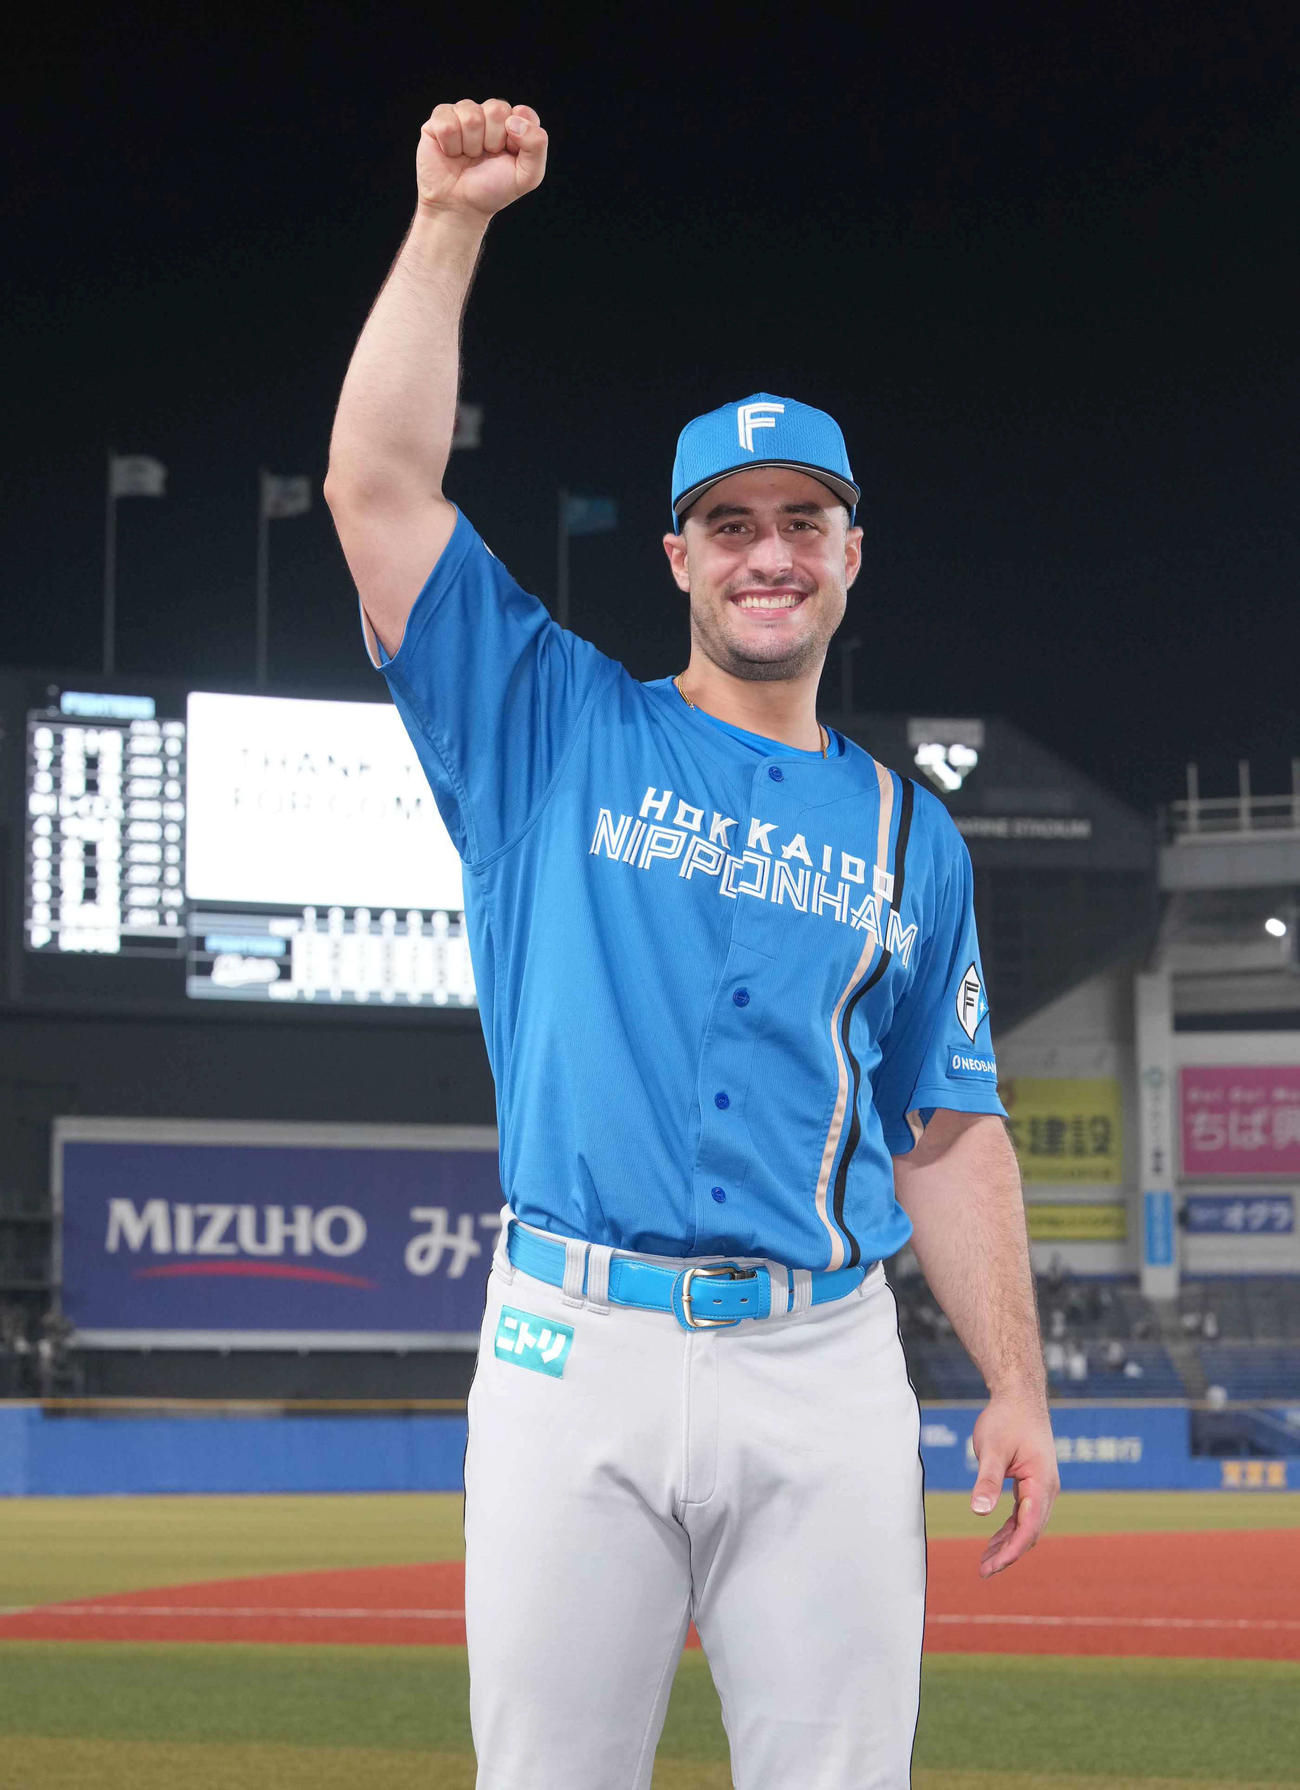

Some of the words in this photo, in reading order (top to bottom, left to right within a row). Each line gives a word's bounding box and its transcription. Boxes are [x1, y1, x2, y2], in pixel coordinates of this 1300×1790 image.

[737, 402, 785, 453] F
[638, 786, 895, 903] HOKKAIDO
[588, 808, 919, 969] NIPPONHAM
[104, 1198, 368, 1257] MIZUHO
[496, 1316, 567, 1364] ニトリ
